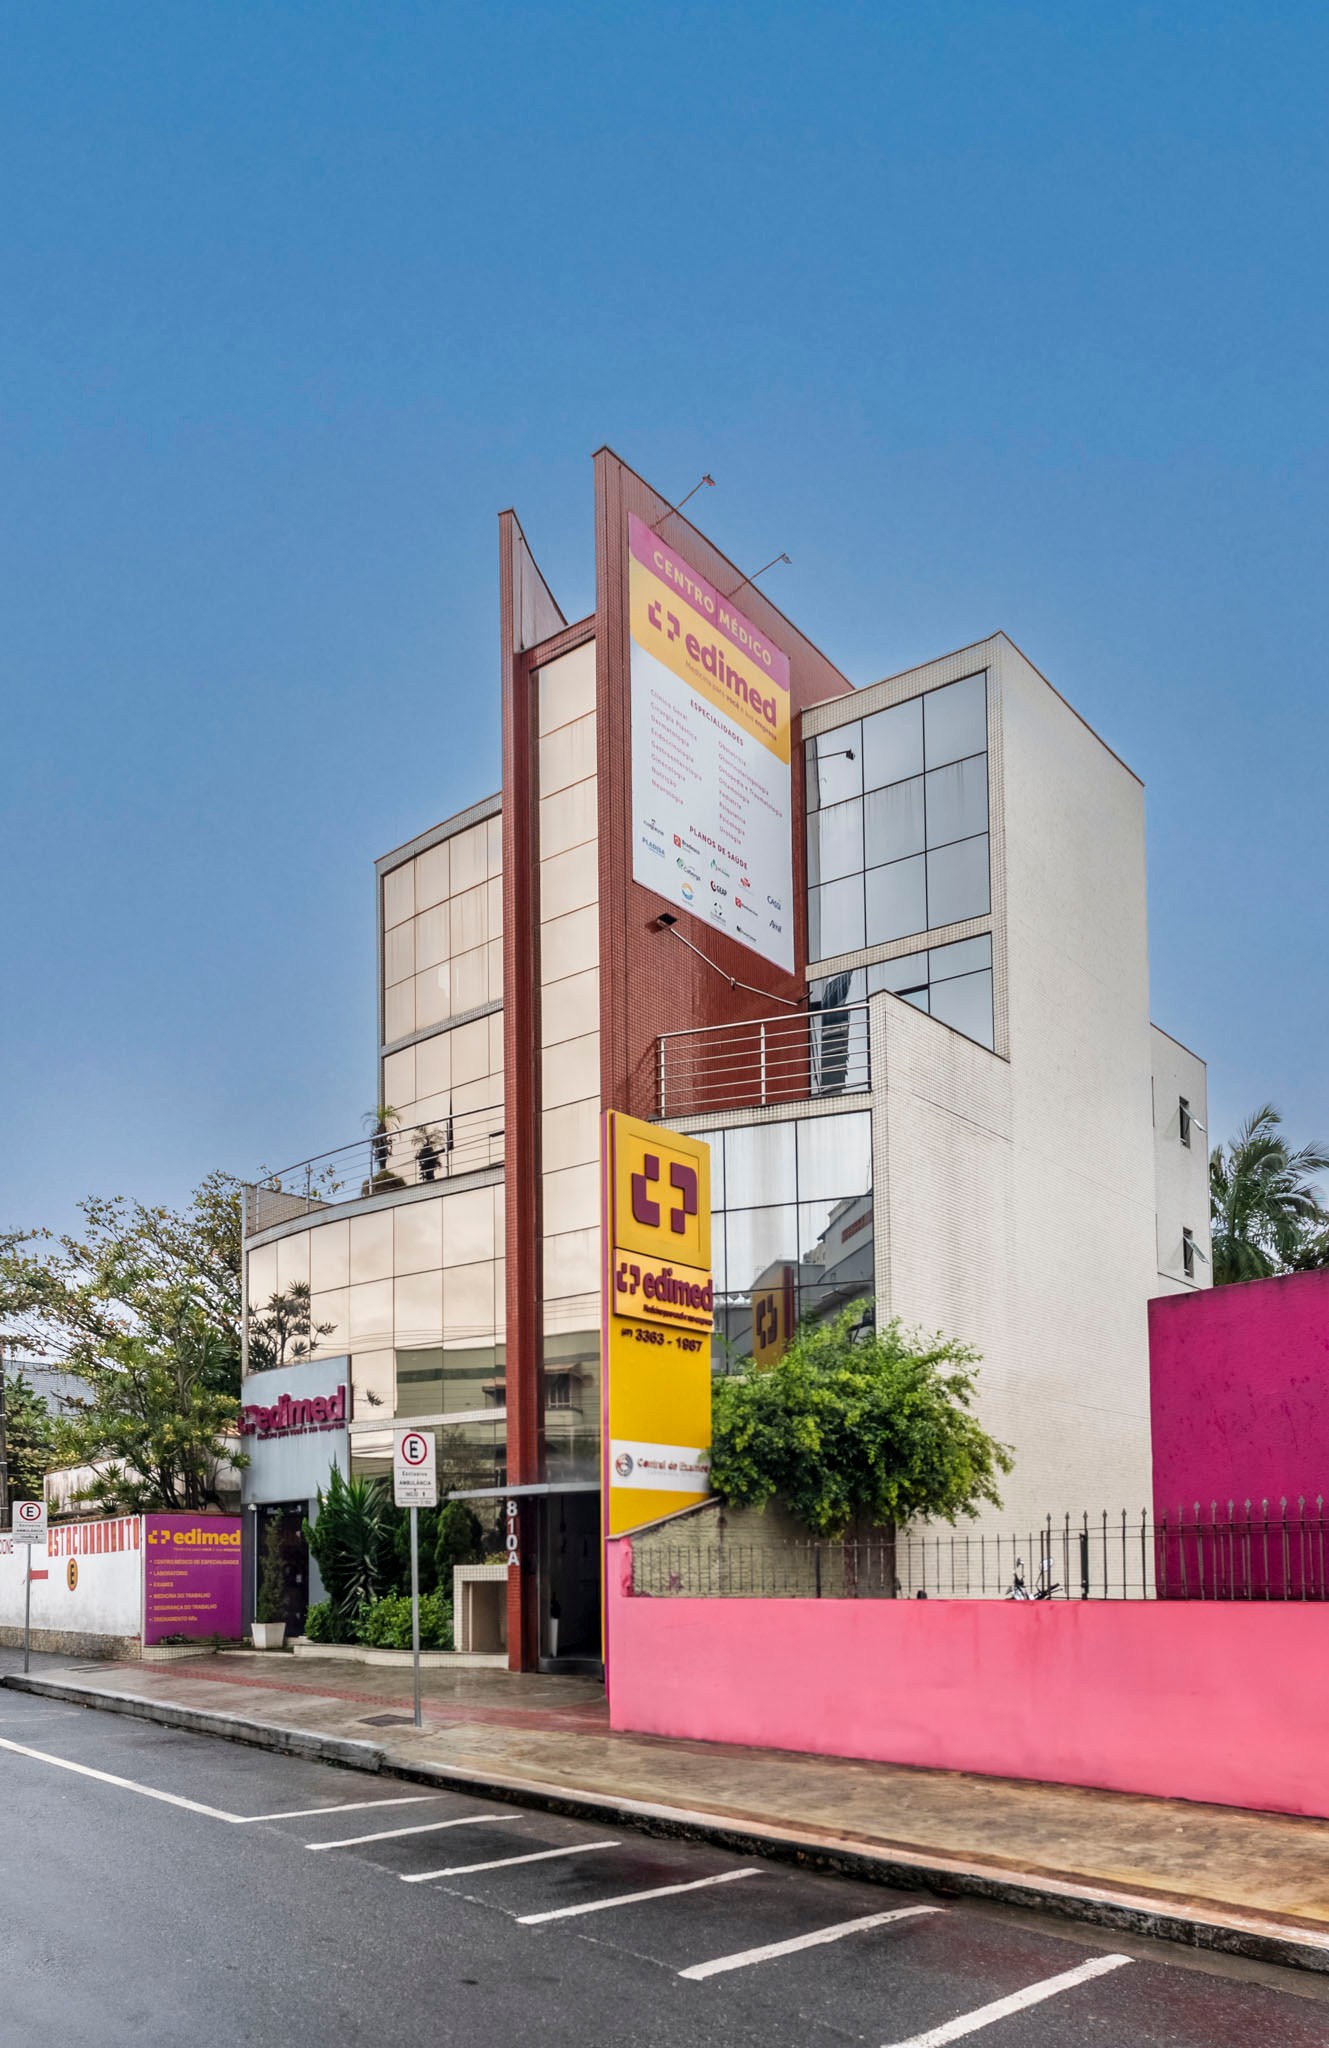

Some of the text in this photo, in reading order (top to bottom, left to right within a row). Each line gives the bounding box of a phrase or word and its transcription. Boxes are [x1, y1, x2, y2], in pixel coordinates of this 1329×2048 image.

[653, 550, 772, 666] CENTRO MÉDICO
[685, 632, 777, 726] edimed
[650, 715, 688, 747] Dermatologia
[690, 700, 743, 745] ESPECIALIDADES
[651, 754, 685, 781] Ginecologia
[651, 767, 676, 787] Nutrição
[651, 780, 683, 806] Neurologia
[749, 789, 782, 818] Traumatologia
[689, 827, 747, 869] PLANOS DE SAÚDE
[719, 827, 741, 844] Urologia
[643, 1267, 713, 1312] edimed
[635, 1328, 665, 1346] 3363
[255, 1384, 346, 1430] edimed
[410, 1440, 419, 1459] E
[637, 1457, 666, 1470] Central
[668, 1462, 678, 1470] de
[26, 1506, 34, 1518] E
[48, 1518, 140, 1557] ESTACIONAMENTO
[173, 1528, 241, 1546] edimed
[506, 1500, 520, 1566] 810A
